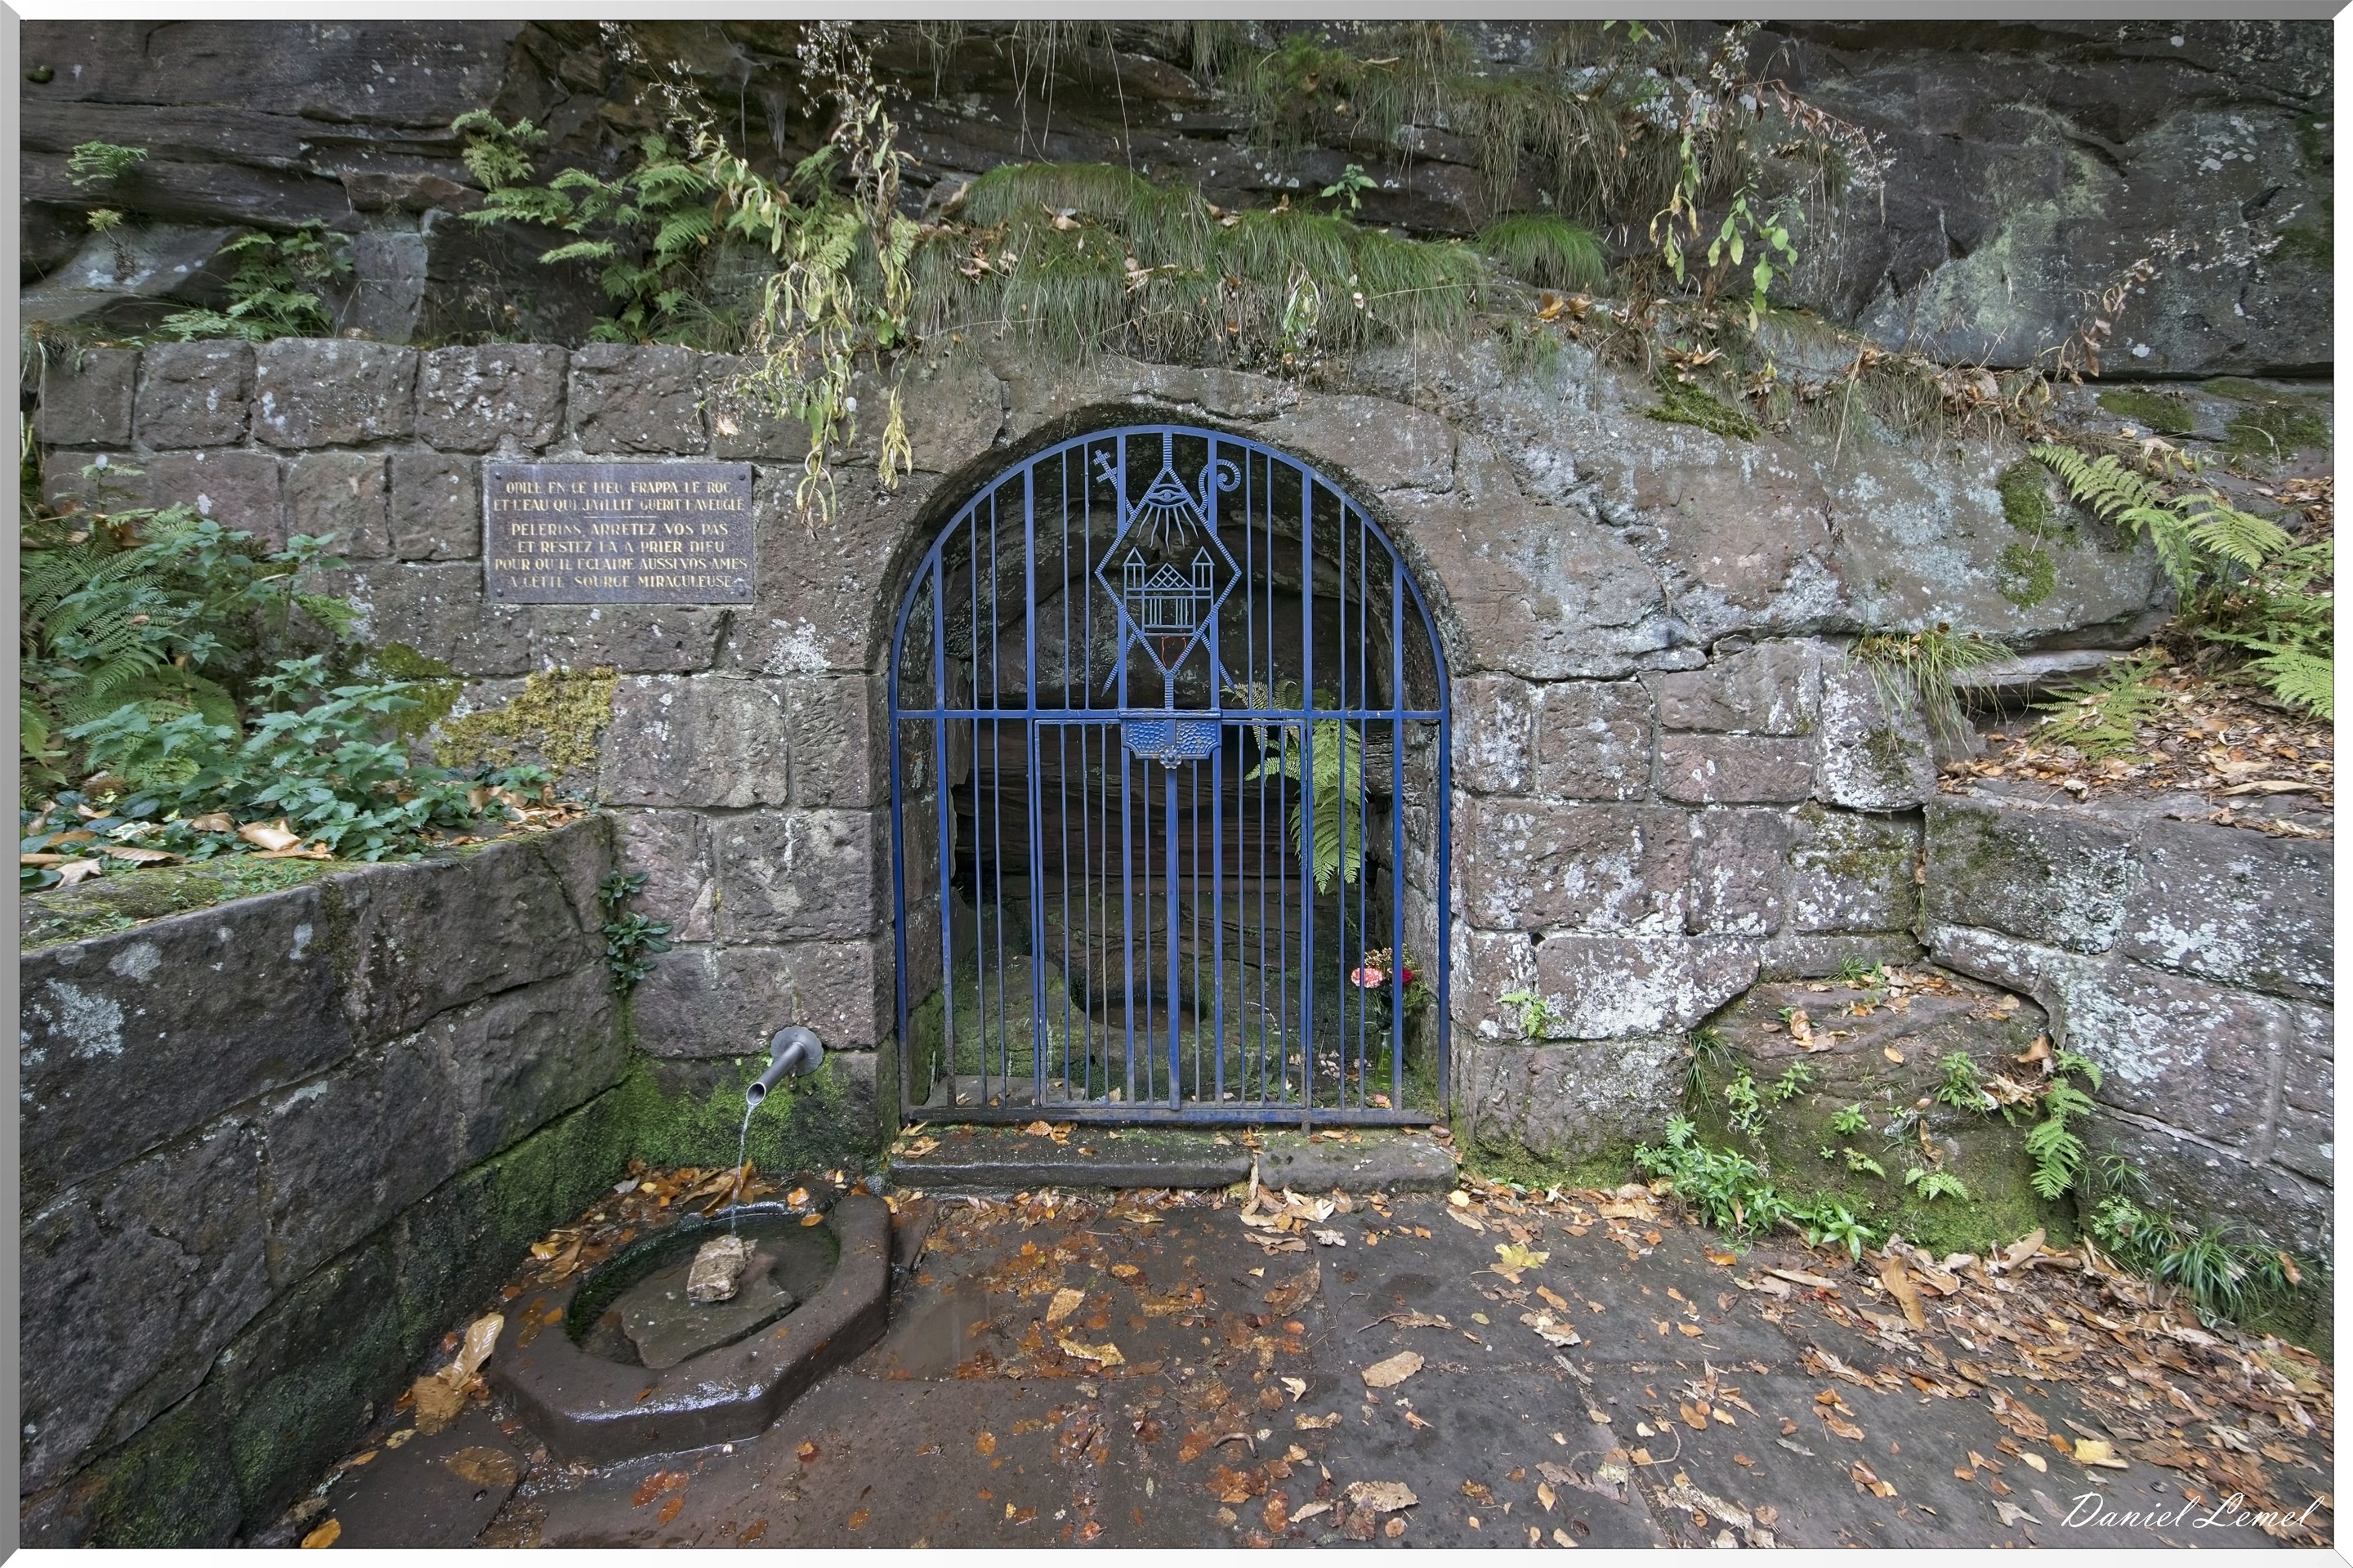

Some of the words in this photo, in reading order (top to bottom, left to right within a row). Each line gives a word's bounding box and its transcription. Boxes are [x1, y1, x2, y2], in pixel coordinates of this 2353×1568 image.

[548, 481, 565, 494] EN
[571, 481, 587, 494] CE
[631, 481, 678, 494] FRAPPA
[685, 481, 699, 494] LE
[707, 481, 731, 494] ROC
[493, 499, 510, 511] ET
[514, 499, 549, 511] L'EAU
[591, 523, 656, 535] ARRETEZ
[663, 523, 694, 535] VOS
[702, 523, 729, 535] PAS
[518, 541, 534, 553] ET
[540, 541, 593, 553] RESTEZ
[624, 541, 635, 553] A
[641, 540, 683, 553] PRIER
[690, 540, 725, 552] DIEU
[494, 558, 531, 571] POUR
[578, 558, 635, 570] ECLAIRE
[639, 558, 677, 570] AUSSI
[679, 558, 707, 570] VOS
[711, 558, 748, 570] AMES
[637, 574, 732, 588] MIRACULEUSE
